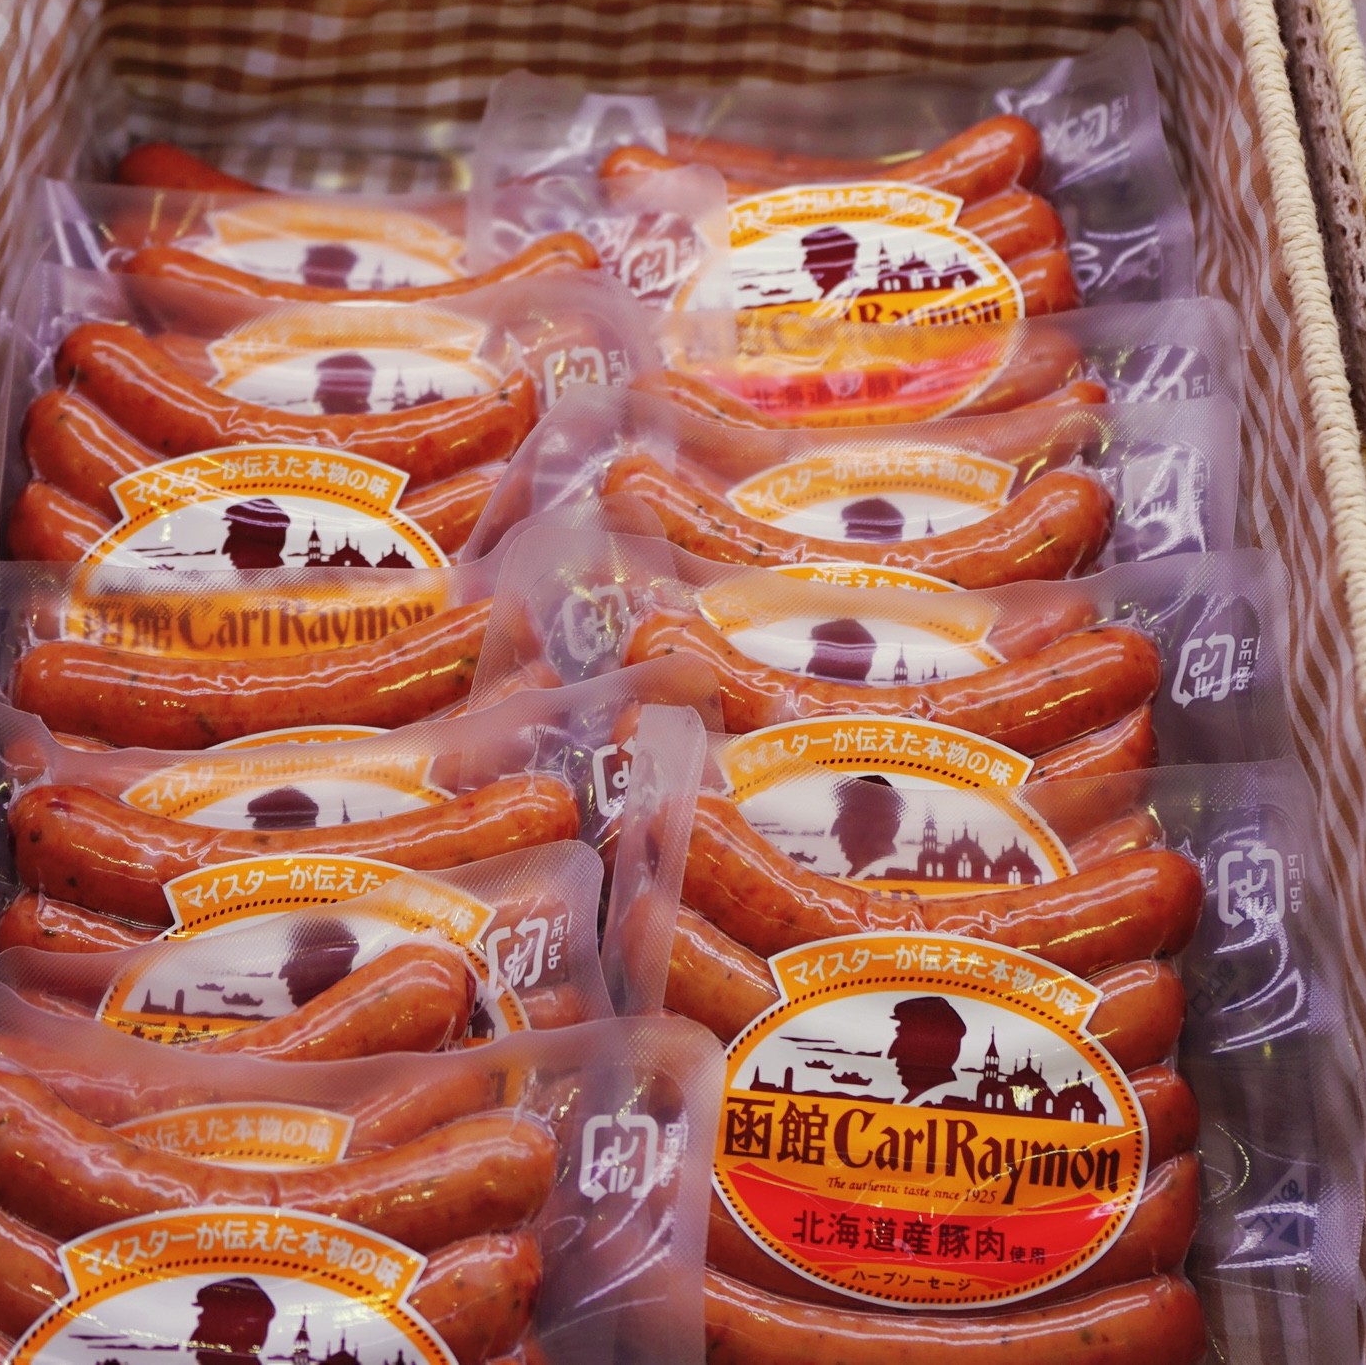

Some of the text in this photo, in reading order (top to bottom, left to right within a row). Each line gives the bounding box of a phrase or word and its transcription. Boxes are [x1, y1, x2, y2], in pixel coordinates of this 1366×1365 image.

[787, 943, 1083, 1016] マイスターが伝えた本物の味
[826, 1177, 998, 1205] The authentic taste since 1925
[79, 1220, 404, 1290] マイスターが伝えた本物の味
[852, 1269, 972, 1292] ハーブソーセージ
